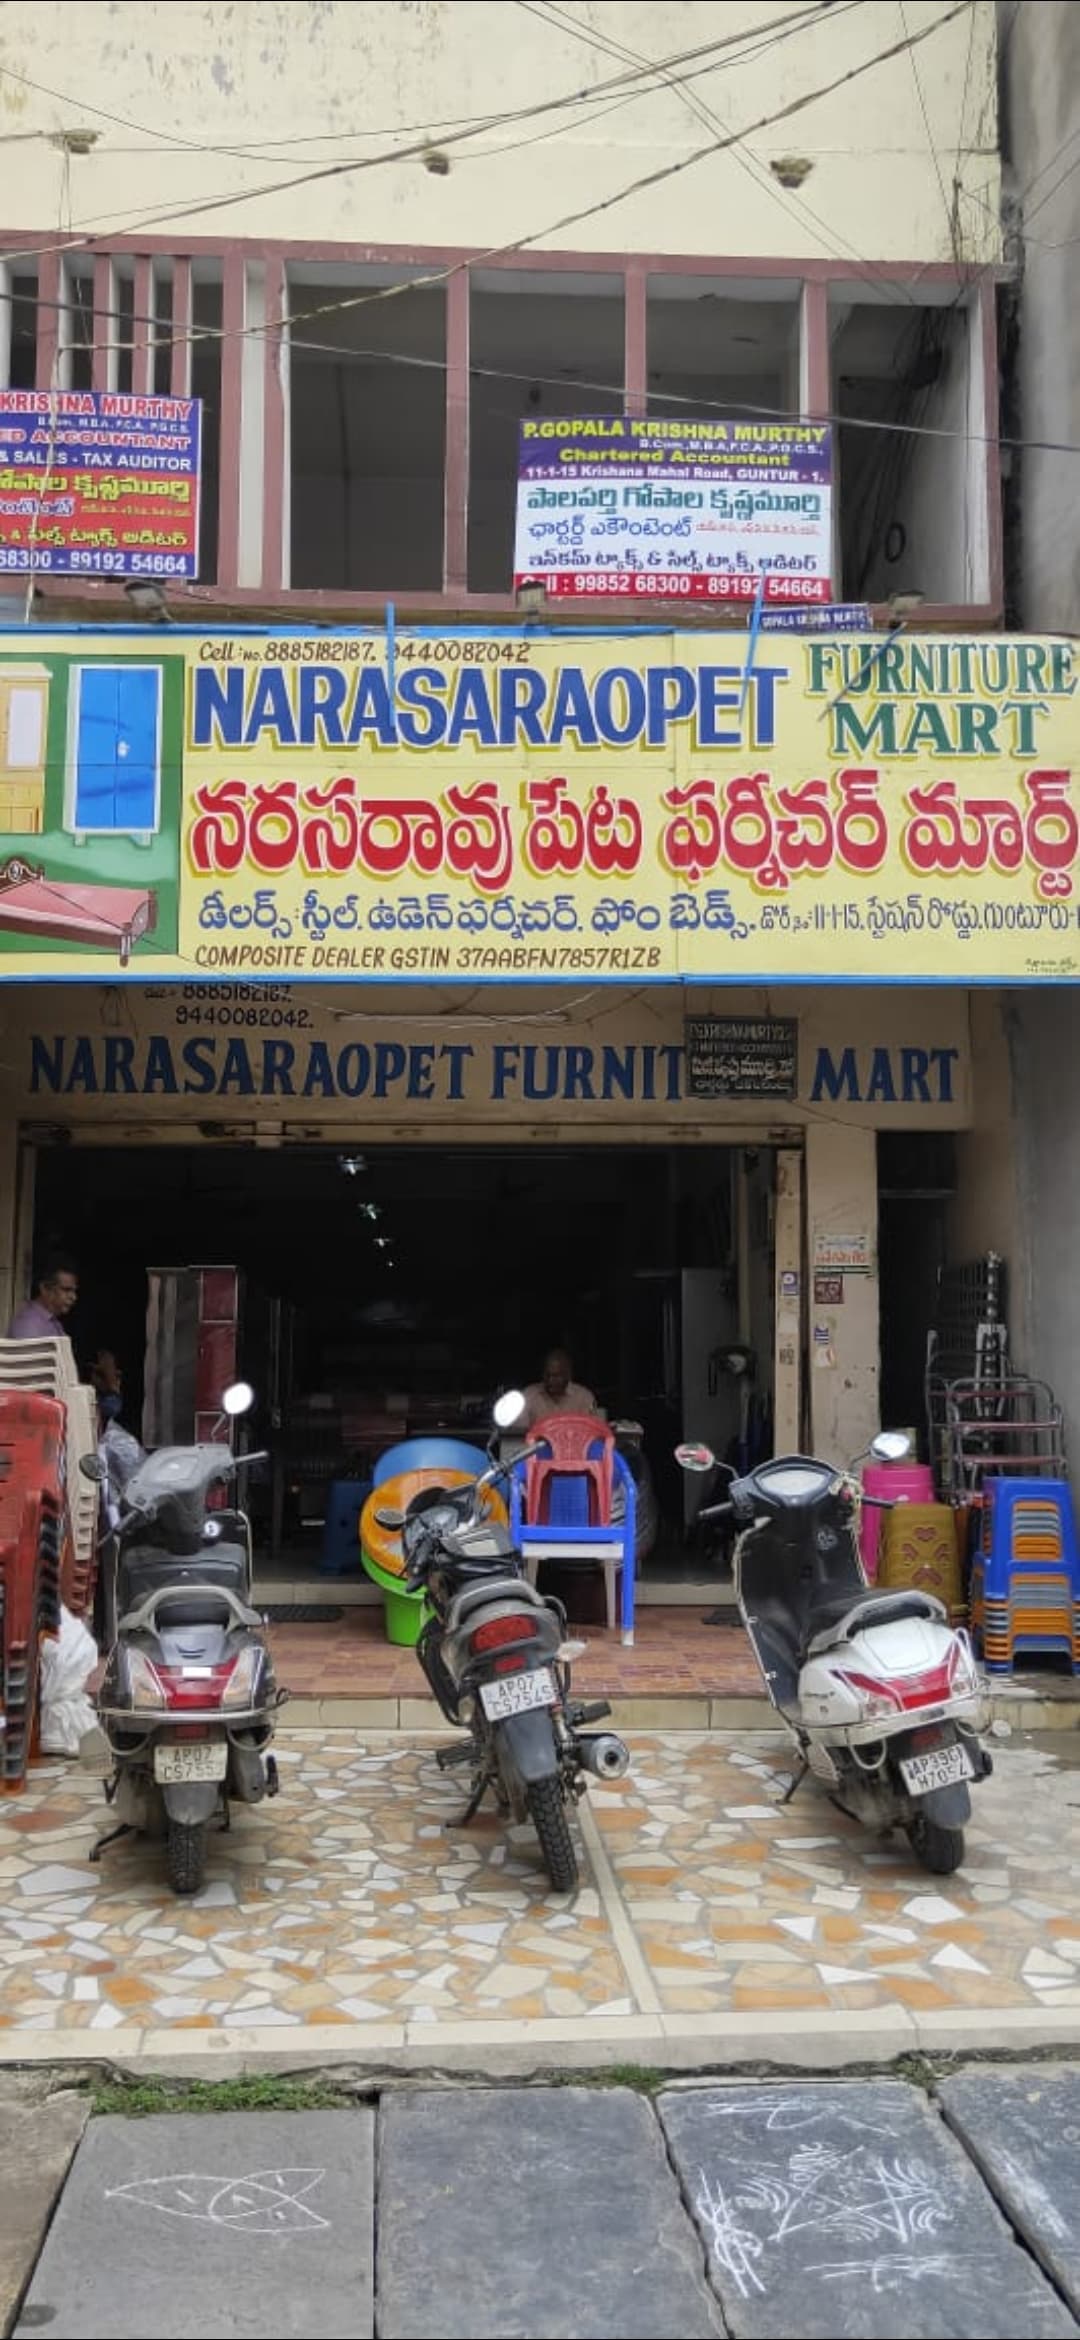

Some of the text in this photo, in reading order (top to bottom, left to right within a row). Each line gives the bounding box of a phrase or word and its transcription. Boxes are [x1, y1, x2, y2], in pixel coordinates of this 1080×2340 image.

[101, 395, 192, 421] MURTHY
[523, 421, 827, 443] P.GOPALA KRISHNA MURTHY
[14, 451, 67, 465] SALS
[83, 453, 112, 466] TAX
[117, 455, 192, 470] AUDITOR
[559, 448, 791, 467] Chartered Accountant
[527, 467, 577, 478] 11-1-15
[581, 465, 643, 478] Krishana
[647, 466, 689, 479] Mahal
[737, 469, 799, 483] GUNTUR
[623, 483, 704, 509] గోపాల
[70, 551, 125, 570] 89192
[131, 553, 187, 573] 54664
[574, 575, 629, 591] 99852
[635, 575, 691, 593] 68300
[769, 578, 823, 597] 54664
[200, 641, 234, 661] Cell
[807, 643, 1078, 695] FURNITURE
[190, 665, 789, 748] NARASARAOPET
[832, 702, 1049, 754] MART
[192, 768, 1079, 898] నరసరావు పేట ఫర్నీచర్ మార్ట్
[195, 945, 661, 969] COMPOSITE DEALER GSTIN 37AABFN7857R1ZB
[28, 1035, 475, 1100] NARASARAOPET
[492, 1045, 687, 1101] FURNIT
[809, 1046, 959, 1102] MART
